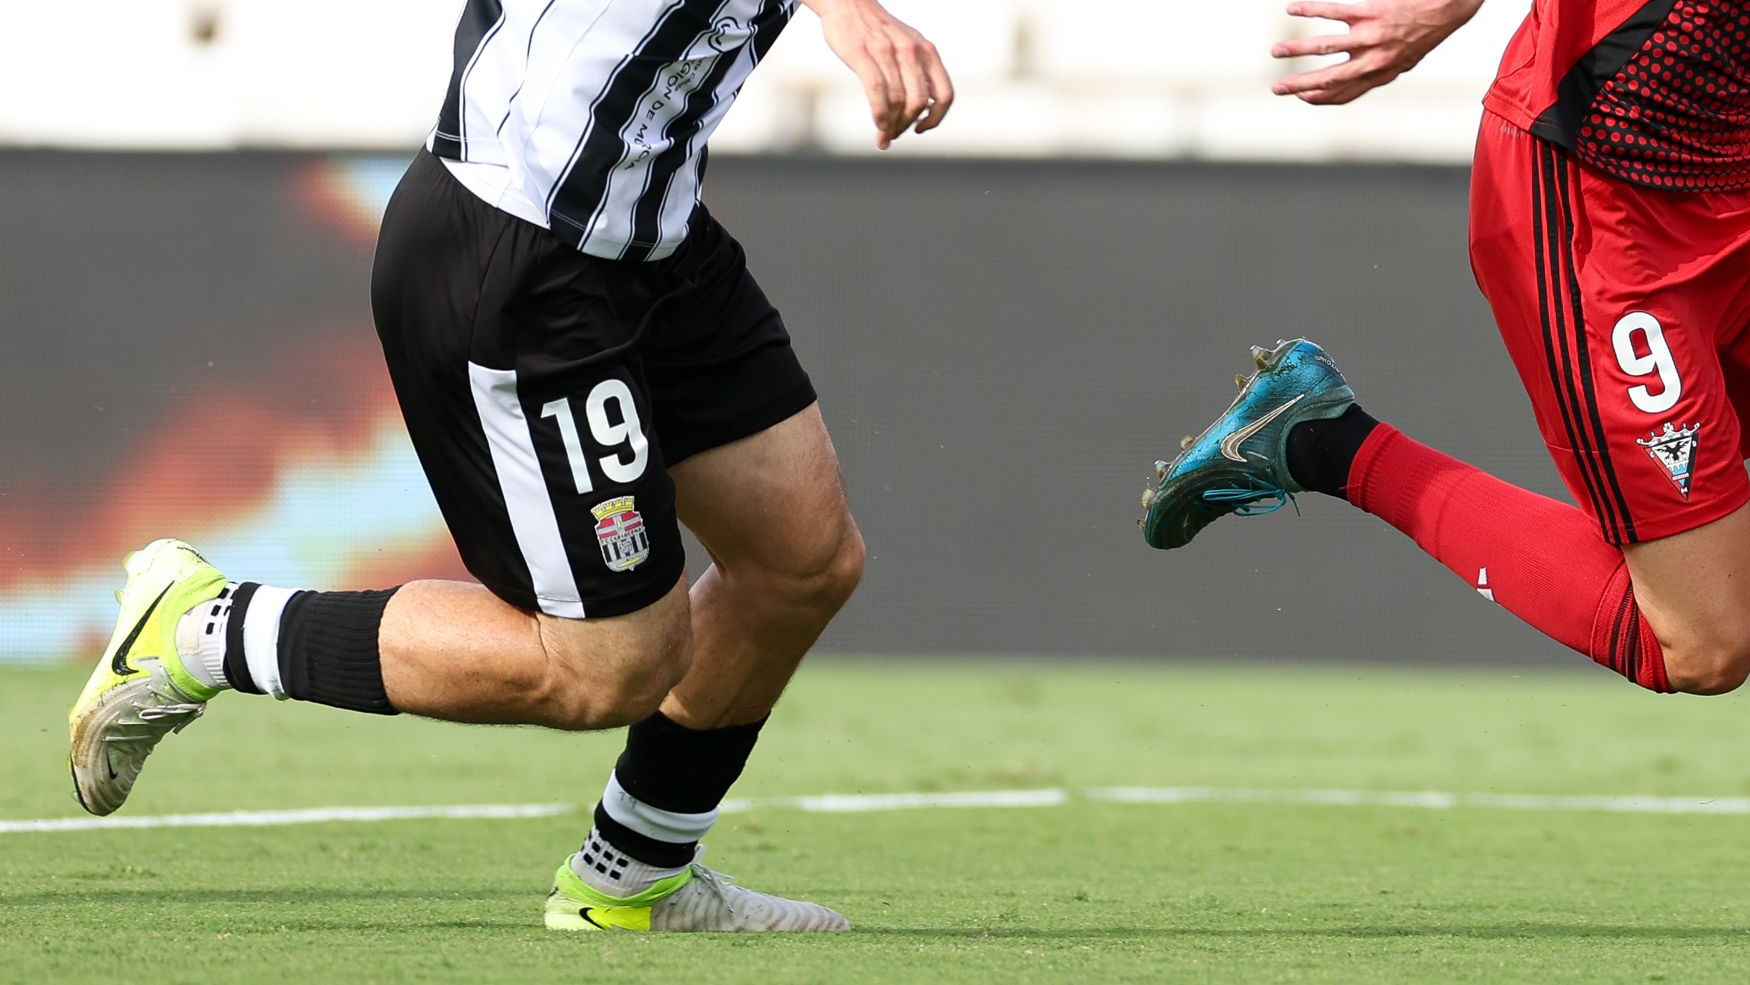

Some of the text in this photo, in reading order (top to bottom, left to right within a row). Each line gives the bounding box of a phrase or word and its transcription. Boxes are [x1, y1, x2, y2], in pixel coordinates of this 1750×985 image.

[647, 100, 664, 121] DE
[1611, 310, 1682, 414] 9
[540, 378, 649, 495] 19
